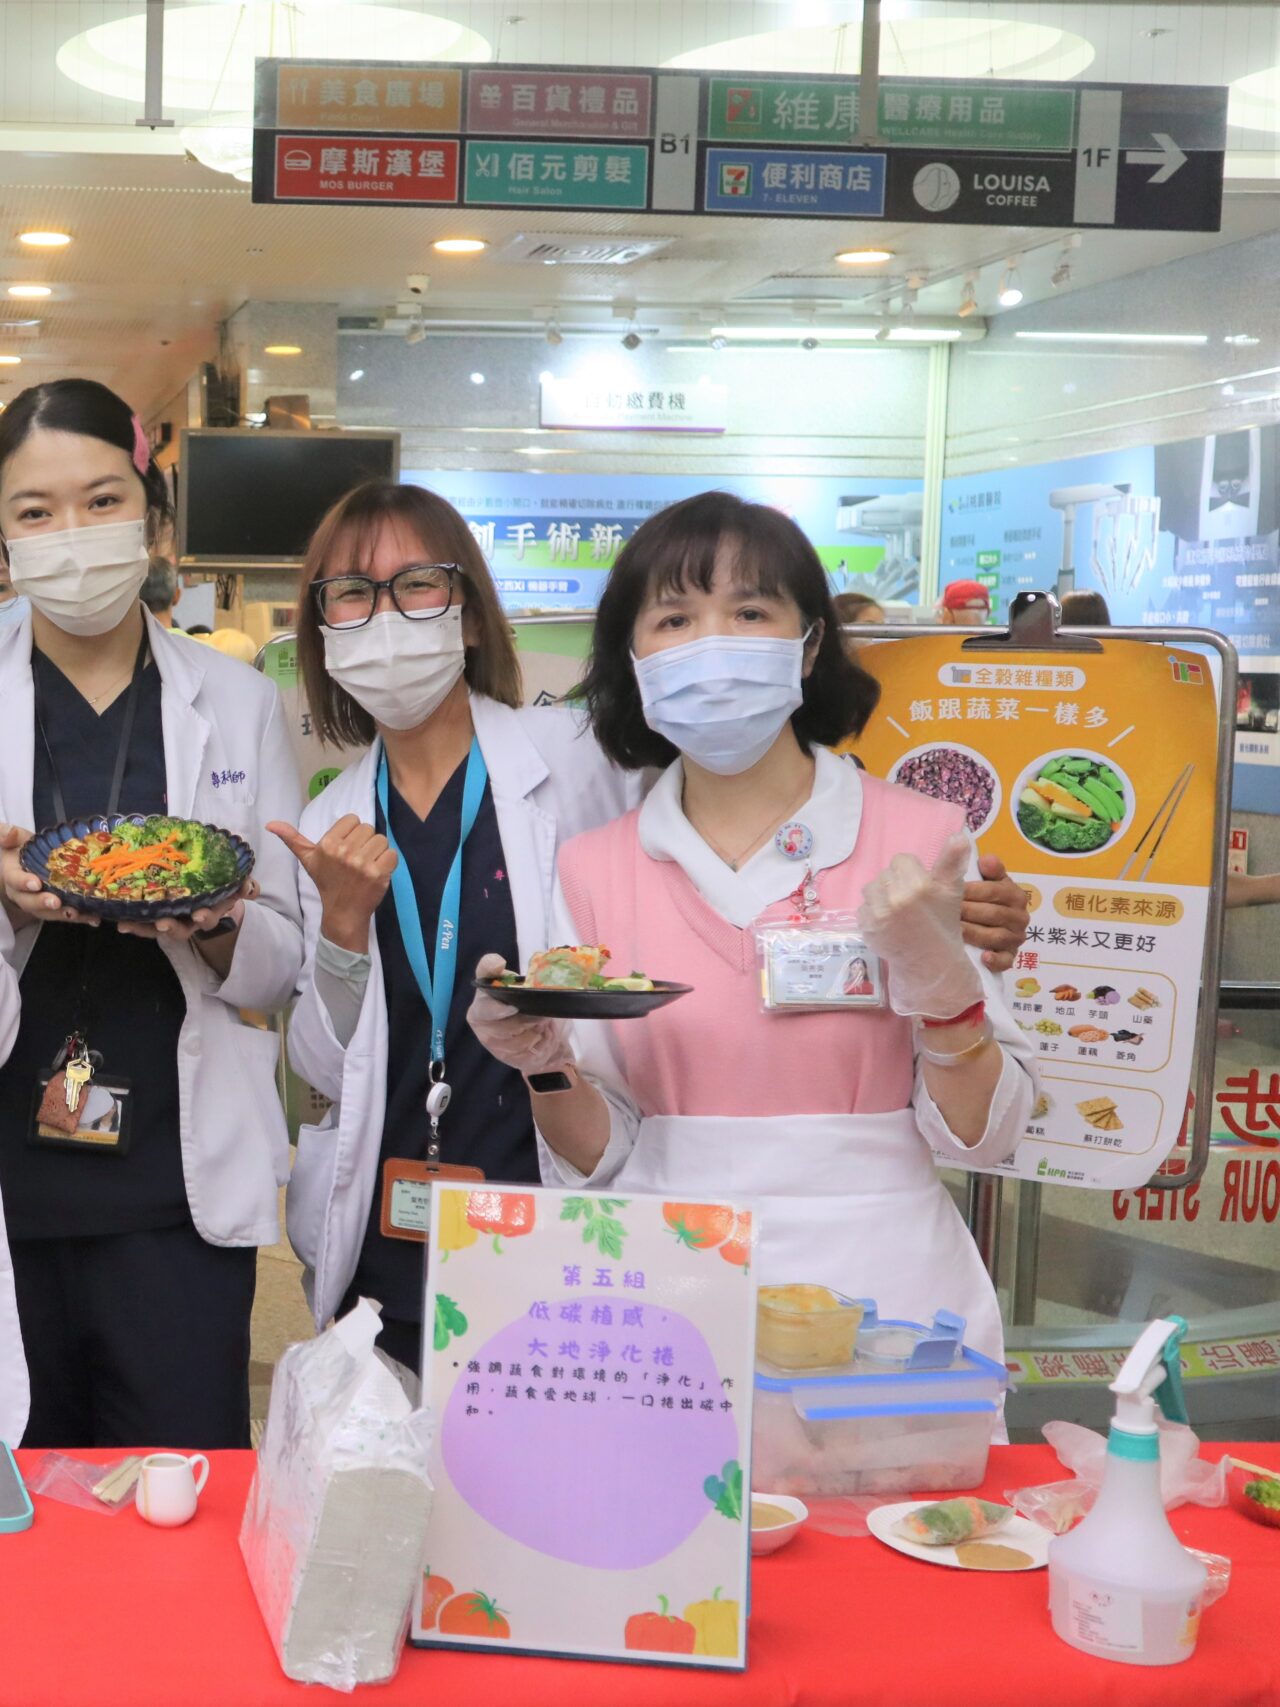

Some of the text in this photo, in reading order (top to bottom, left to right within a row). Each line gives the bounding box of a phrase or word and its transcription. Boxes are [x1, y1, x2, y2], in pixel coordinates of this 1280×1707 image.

[320, 79, 446, 109] 美食廣場
[512, 84, 639, 115] 百貨禮品
[659, 132, 690, 155] B1
[319, 147, 446, 178] 摩斯漢堡
[508, 152, 632, 184] 佰元剪髮
[1081, 149, 1111, 168] 1F
[319, 179, 394, 191] MOS BURGER
[761, 161, 872, 192] 便利商店
[973, 172, 1051, 193] LOUISA
[508, 186, 563, 196] Hair Salon
[986, 194, 1038, 208] COFFEE
[468, 520, 640, 563] 創手術新
[908, 697, 1110, 729] 飯跟蔬菜一樣多
[1065, 893, 1177, 919] 植化素來源
[1025, 925, 1156, 953] 米紫米又更好
[1055, 1006, 1076, 1017] 地瓜
[1088, 1009, 1109, 1020] 芋頭
[1039, 1042, 1060, 1052] 蓮子
[1116, 1051, 1137, 1062] 菱角
[1083, 1133, 1124, 1149] 蘇打餅乾
[563, 1264, 646, 1289] 第五組
[527, 1337, 675, 1366] 大地淨化捲
[1199, 1338, 1280, 1370] 站穩
